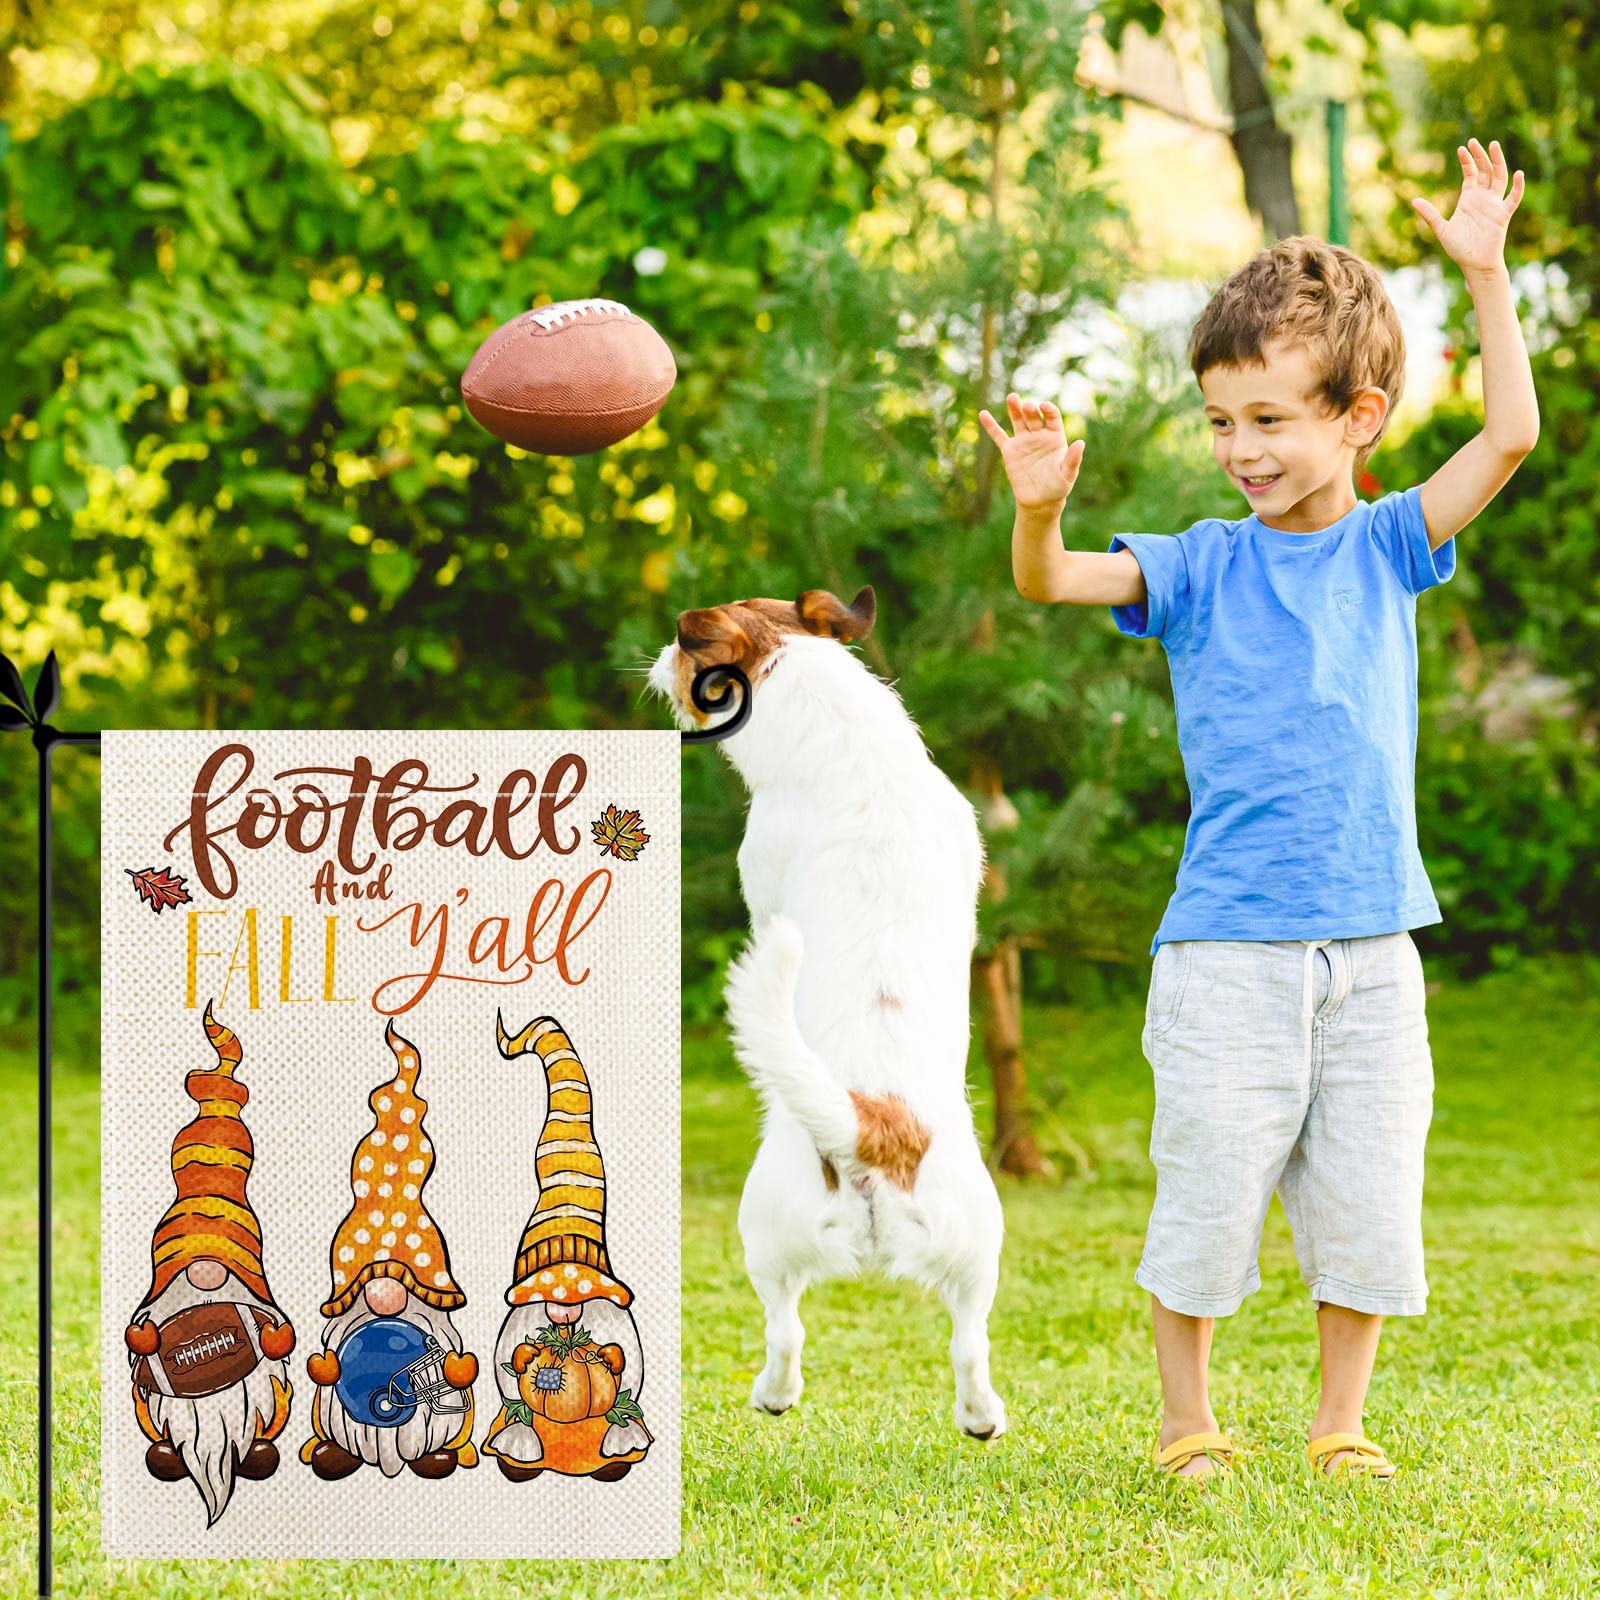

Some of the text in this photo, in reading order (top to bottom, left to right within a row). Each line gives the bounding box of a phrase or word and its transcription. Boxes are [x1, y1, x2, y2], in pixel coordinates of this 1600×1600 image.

[164, 743, 587, 900] football
[310, 860, 393, 905] And
[184, 908, 356, 1010] FALL
